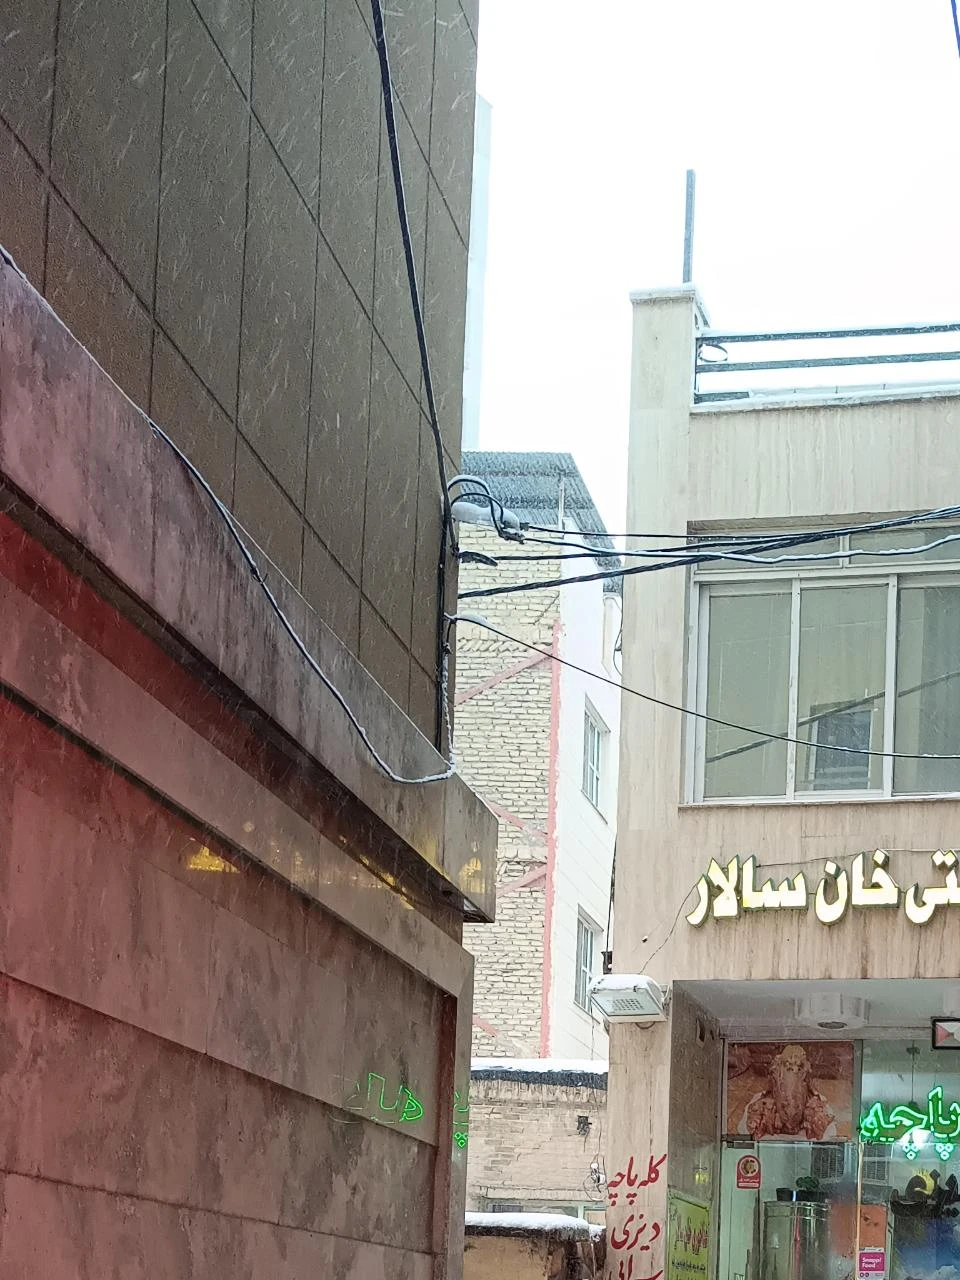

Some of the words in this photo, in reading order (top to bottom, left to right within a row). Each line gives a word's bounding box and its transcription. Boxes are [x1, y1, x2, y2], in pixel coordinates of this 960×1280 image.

[685, 853, 809, 928] سالار
[814, 848, 900, 926] خان
[607, 1156, 639, 1206] پاچه
[637, 1153, 668, 1189] کله
[610, 1213, 661, 1251] دیزی
